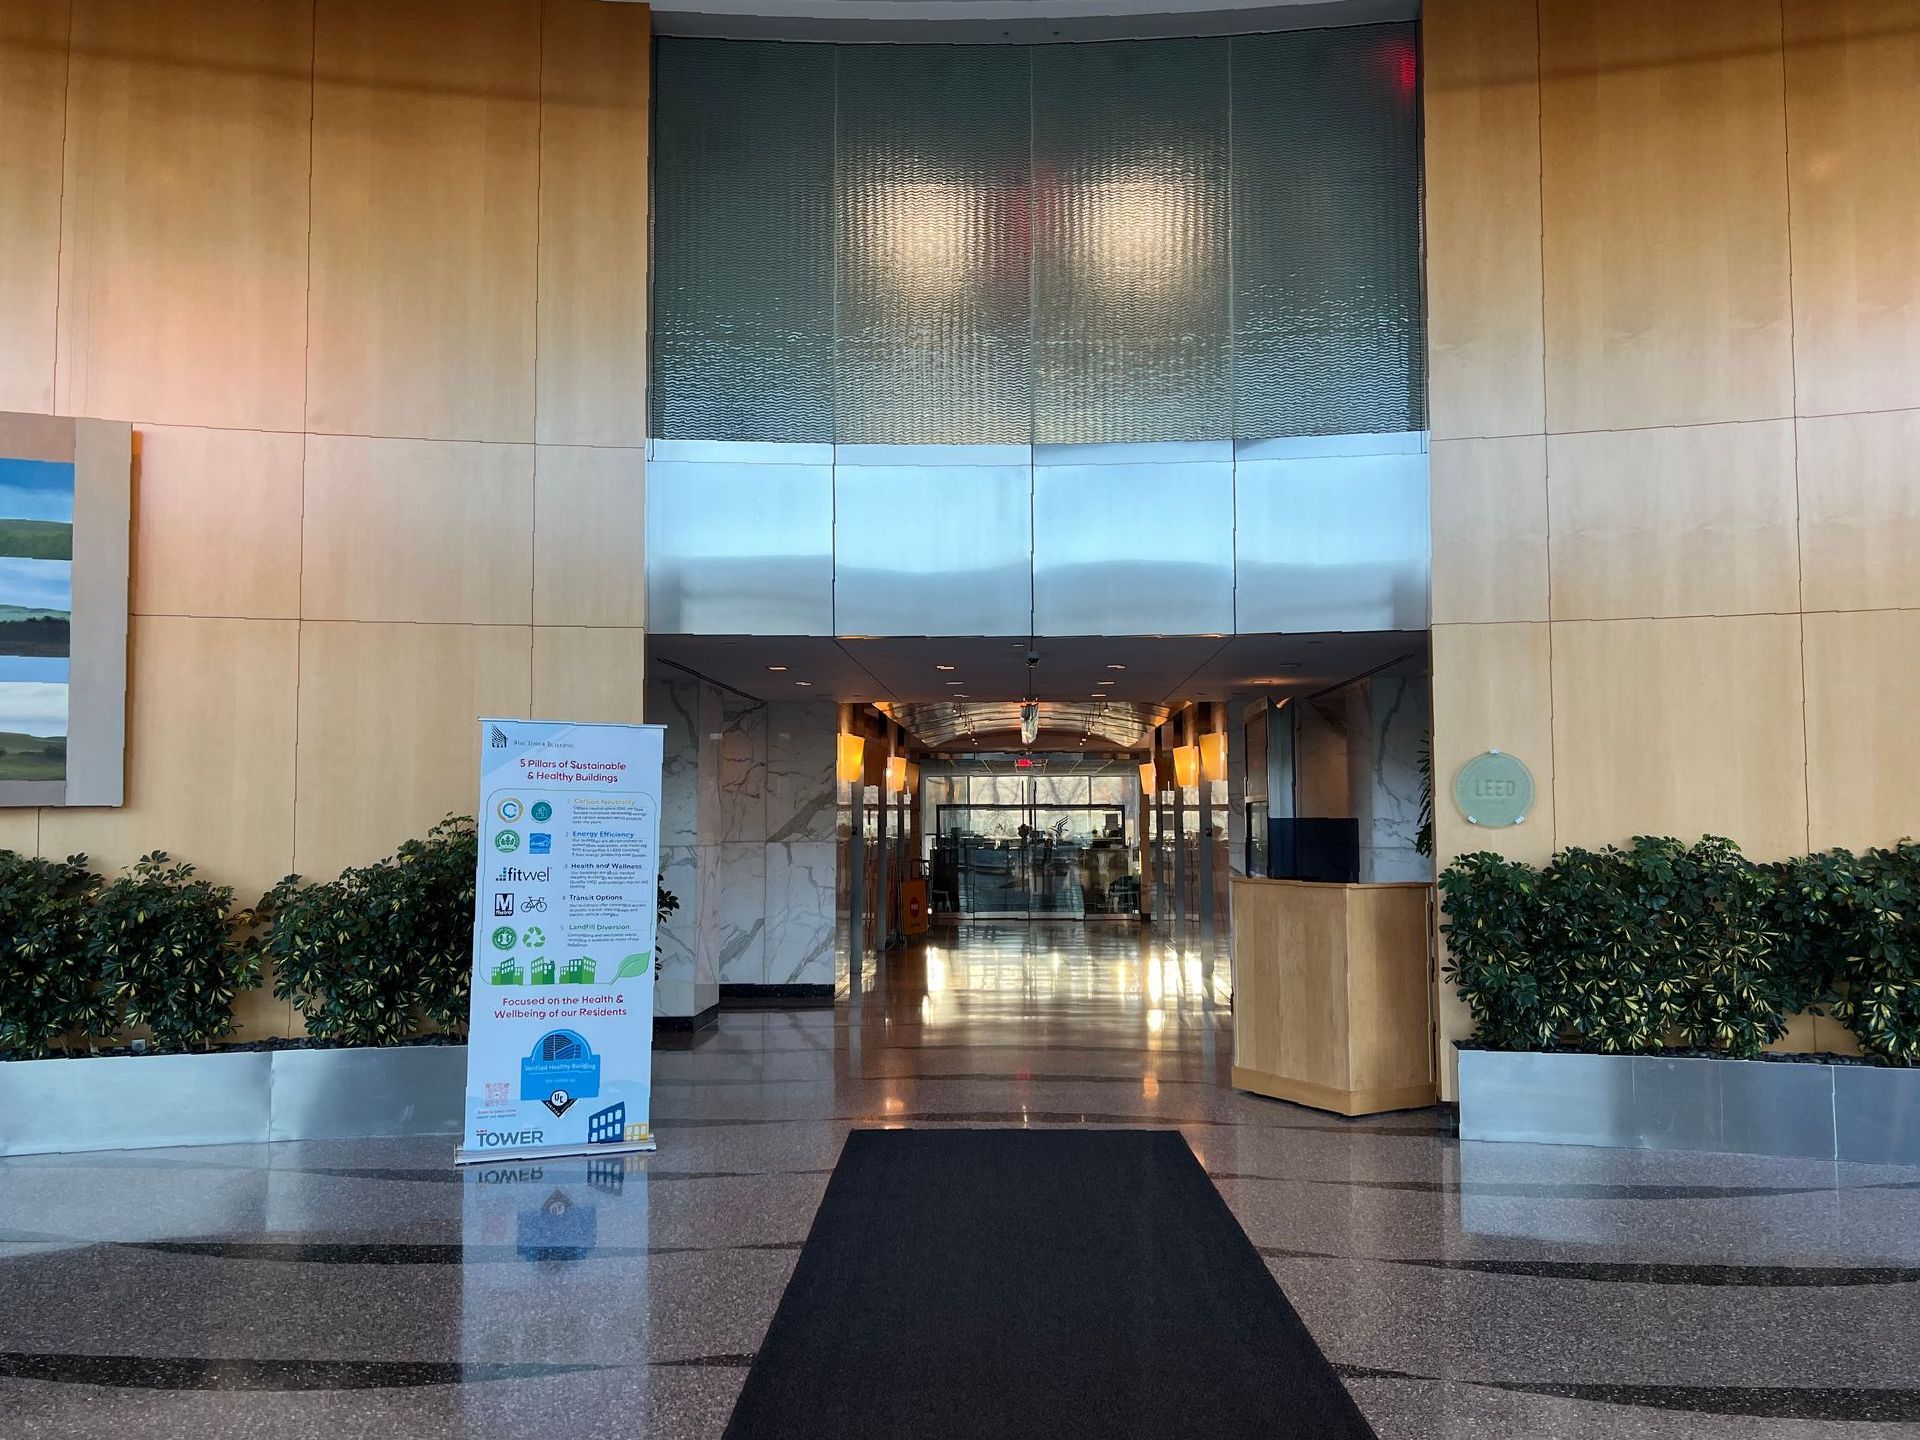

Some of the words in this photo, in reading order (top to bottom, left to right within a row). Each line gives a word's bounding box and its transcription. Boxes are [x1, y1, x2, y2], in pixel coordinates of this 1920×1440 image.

[520, 759, 526, 767] 5
[528, 759, 557, 768] Pillars
[559, 760, 569, 768] of
[570, 761, 627, 770] Sustainable
[527, 772, 534, 780] &
[537, 772, 573, 783] Healthy
[576, 773, 618, 784] Buildings
[1475, 779, 1516, 797] LEED
[600, 831, 635, 839] Efficiency
[508, 866, 550, 882] fitwel
[495, 894, 513, 911] M
[596, 894, 623, 902] Options
[502, 997, 545, 1006] Focused
[548, 997, 560, 1006] on
[562, 996, 579, 1005] the
[581, 995, 614, 1004] Health
[616, 994, 624, 1003] &
[494, 1009, 546, 1020] Wellbeing
[548, 1009, 559, 1018] of
[561, 1009, 577, 1018] our
[579, 1007, 627, 1017] Residents
[476, 1130, 544, 1148] TOWER
